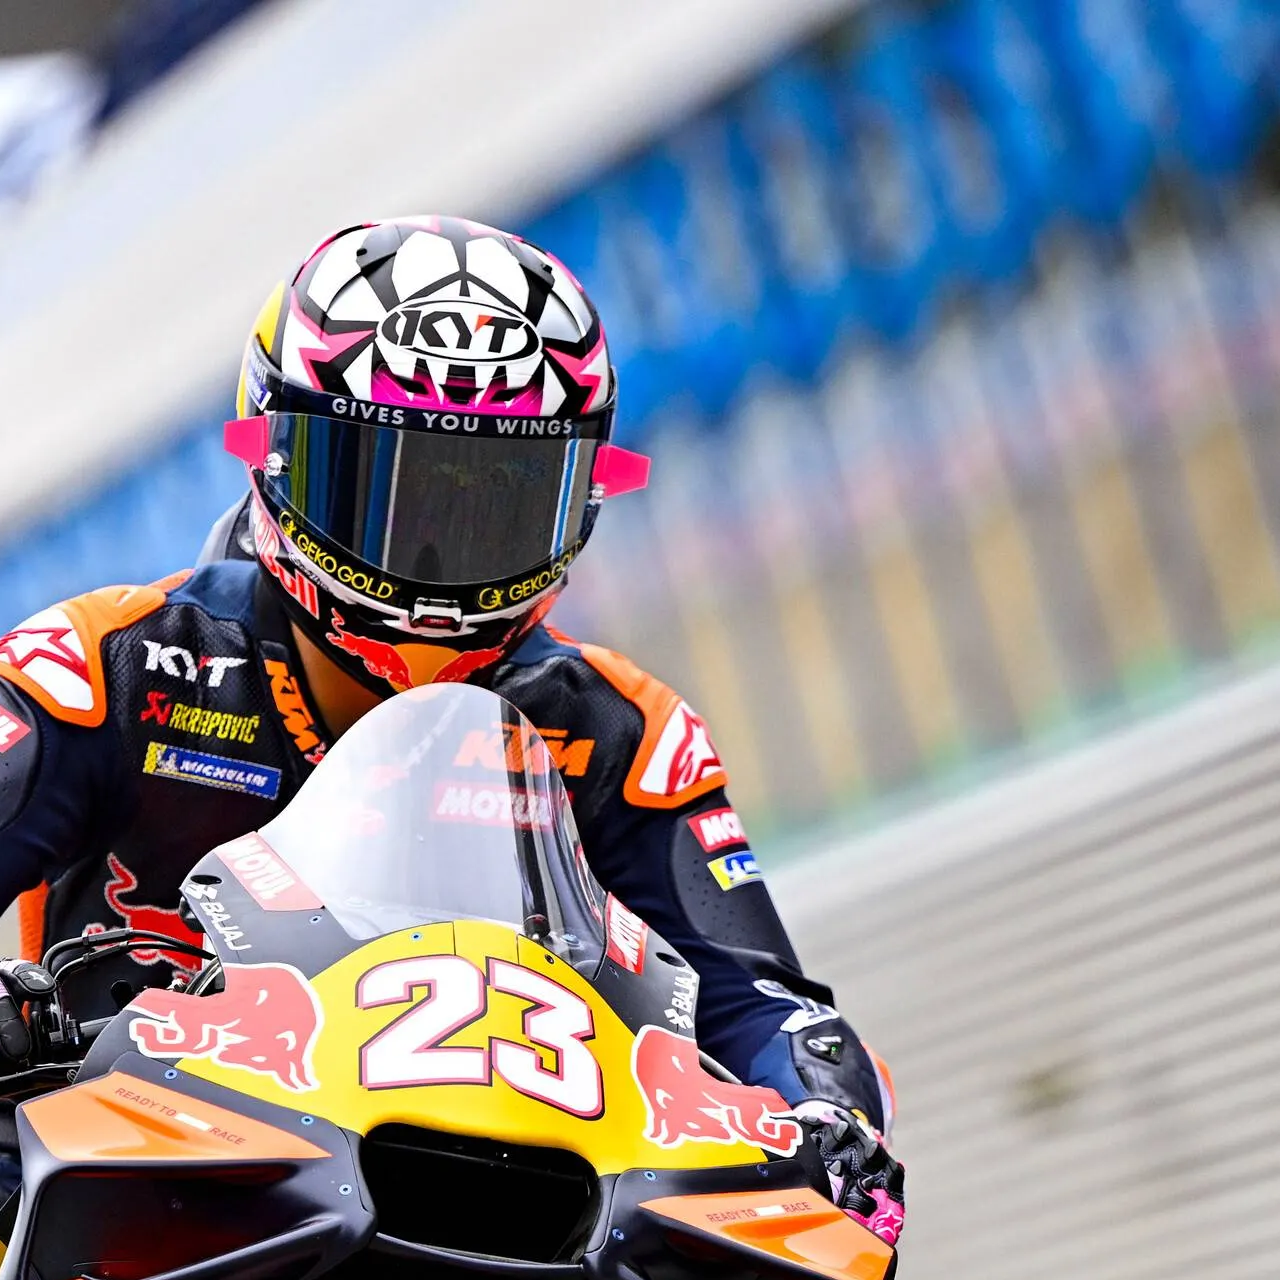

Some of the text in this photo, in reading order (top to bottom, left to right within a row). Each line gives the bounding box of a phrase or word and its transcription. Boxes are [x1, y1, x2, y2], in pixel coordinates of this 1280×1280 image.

[398, 309, 525, 354] KYT
[331, 397, 573, 436] GIVES YOU WINGS
[296, 533, 338, 574] GEKO
[337, 565, 394, 600] GOLD
[508, 570, 550, 601] GEKO
[142, 639, 249, 688] KYT
[263, 658, 320, 752] KTM
[179, 759, 269, 788] MICHELIN
[452, 721, 596, 778] KTM
[436, 786, 552, 827] MOTUL
[225, 837, 296, 901] MOTUL
[199, 901, 252, 951] BAJAJ
[356, 954, 605, 1120] 23
[115, 1087, 247, 1146] READY TO RACE
[706, 1200, 813, 1223] READY TO RACE
